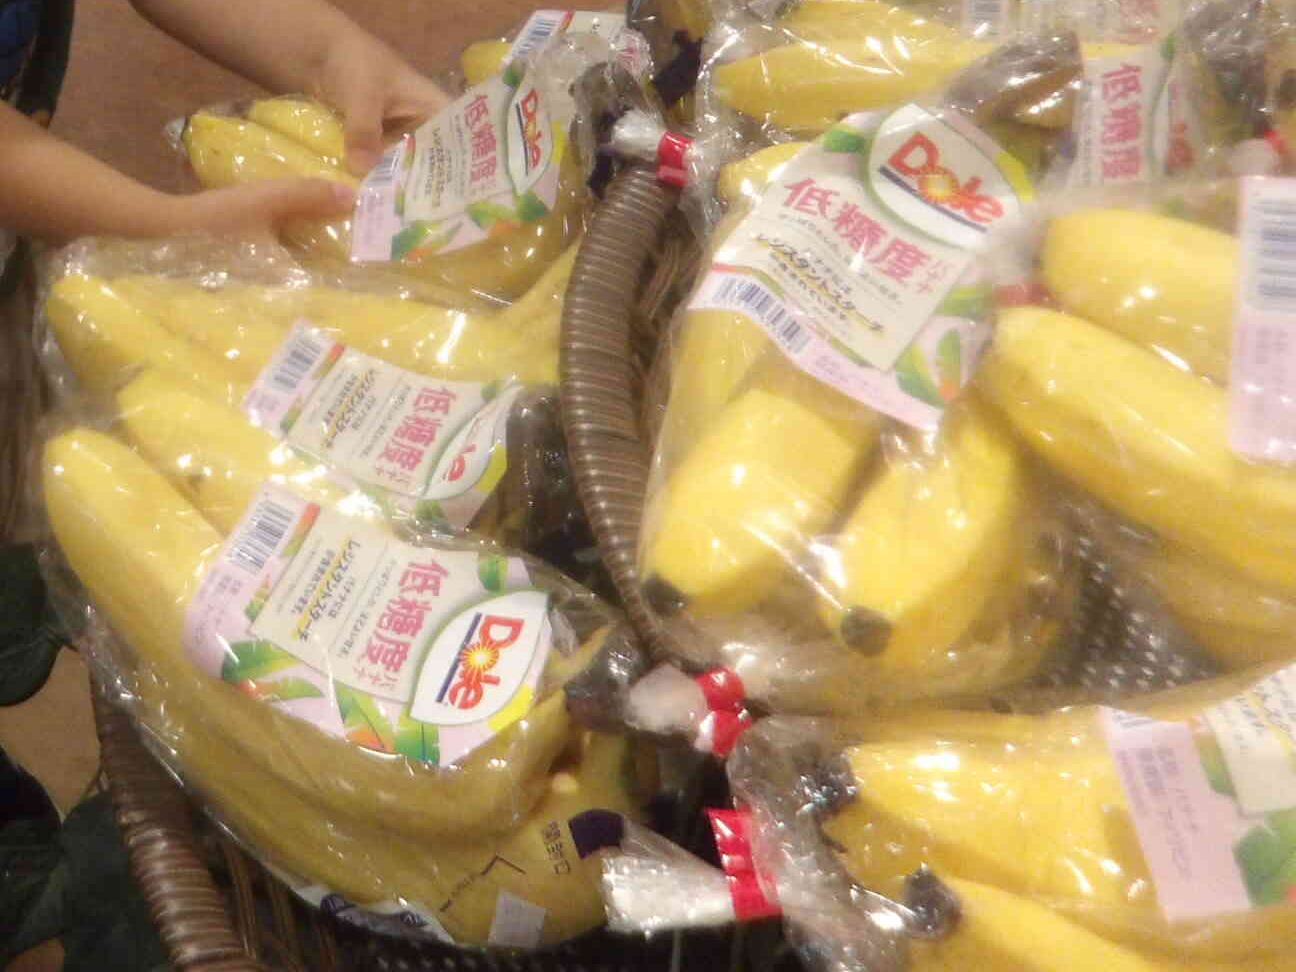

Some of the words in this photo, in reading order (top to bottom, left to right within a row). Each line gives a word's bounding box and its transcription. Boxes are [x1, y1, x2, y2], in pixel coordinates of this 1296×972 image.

[888, 131, 1004, 224] Dole
[782, 177, 933, 283] 低糖度
[383, 384, 457, 473] 低糖度
[363, 557, 450, 674] 低糖度
[447, 614, 526, 712] Dole
